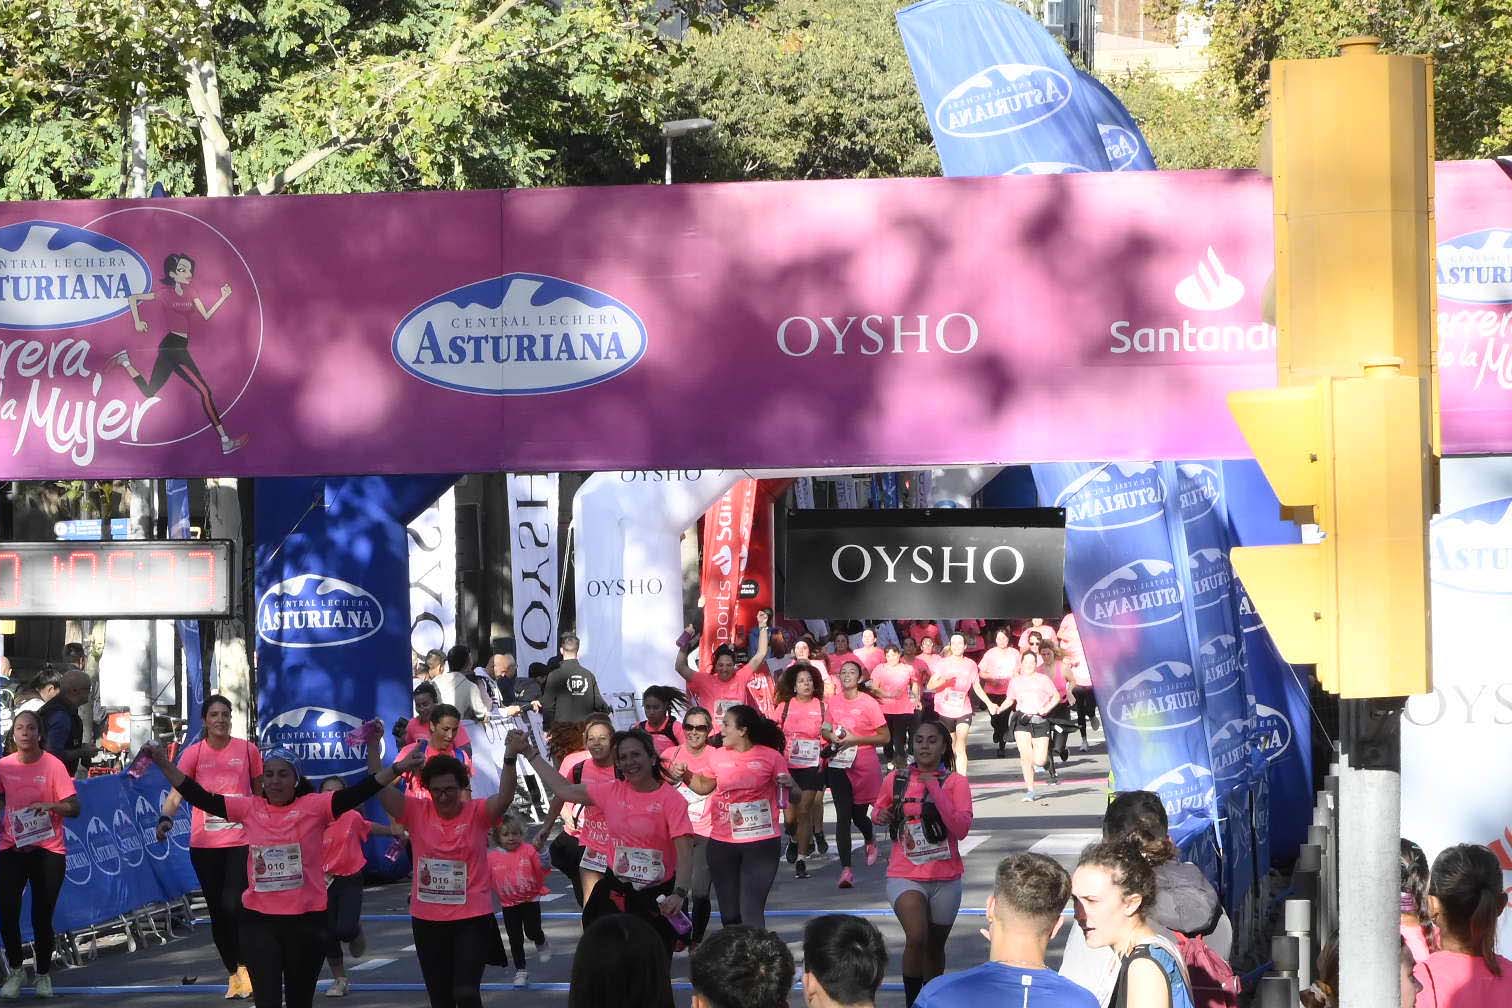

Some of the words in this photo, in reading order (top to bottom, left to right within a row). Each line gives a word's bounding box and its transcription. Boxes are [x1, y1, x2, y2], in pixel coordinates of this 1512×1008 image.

[55, 256, 127, 267] LECHERA
[451, 315, 530, 330] CENTRAL
[538, 313, 618, 327] LECHERA
[412, 320, 627, 366] ASTURIANA
[776, 312, 979, 358] OYSHO
[13, 374, 161, 467] Mujer
[830, 544, 1025, 585] OYSHO
[587, 579, 663, 598] OYSHO
[261, 604, 375, 632] ASTURIANA
[268, 862, 285, 871] 016
[630, 864, 648, 873] 016
